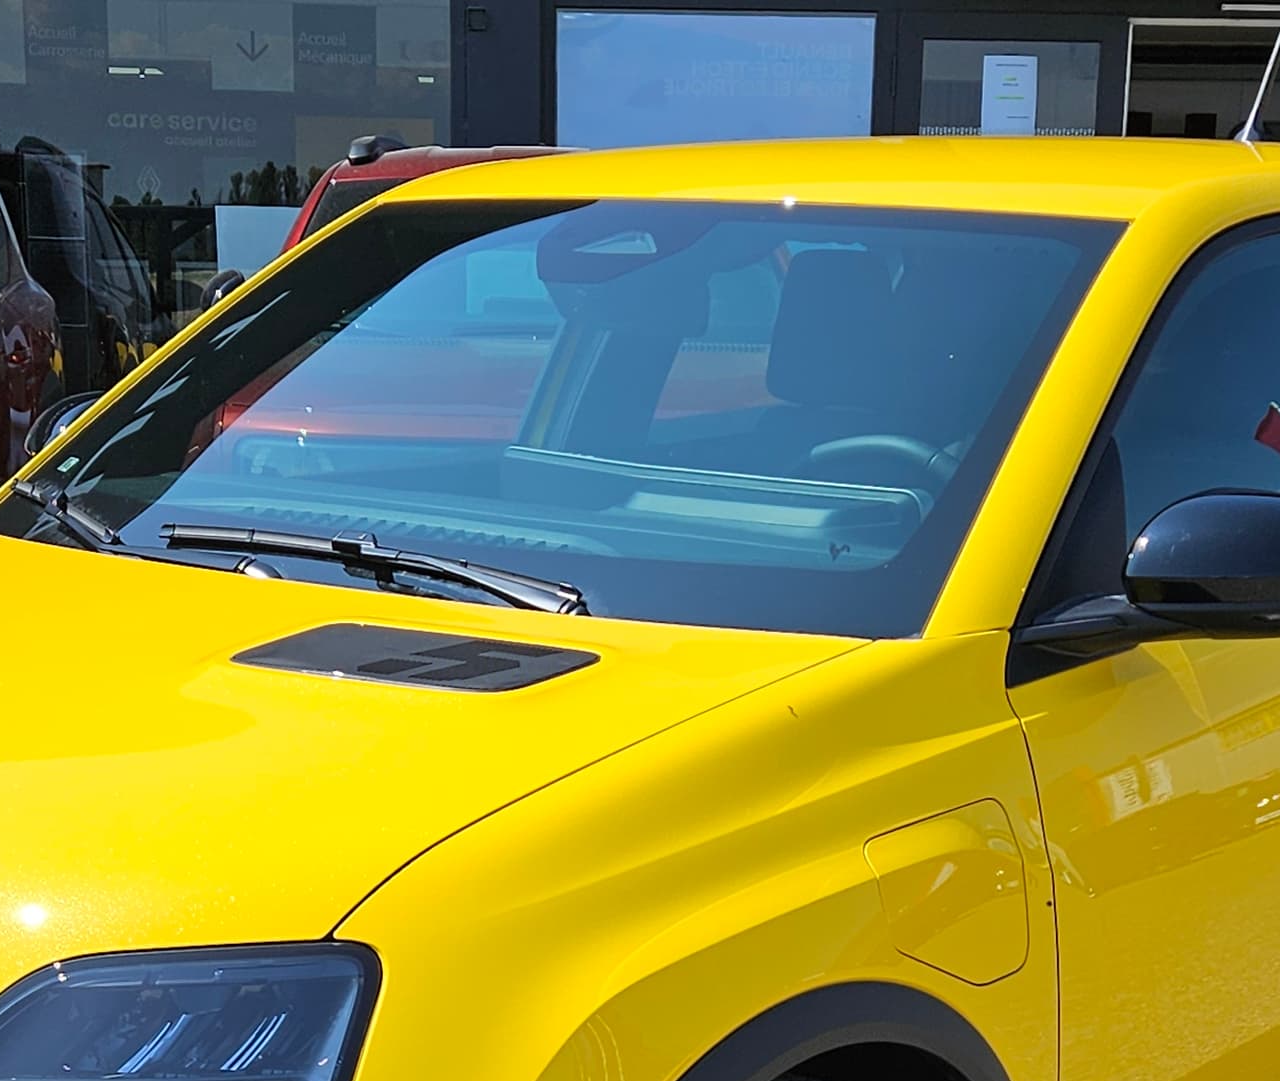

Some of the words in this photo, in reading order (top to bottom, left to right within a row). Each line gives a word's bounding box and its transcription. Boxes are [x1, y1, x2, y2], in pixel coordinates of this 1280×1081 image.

[28, 24, 77, 39] Accueil
[298, 31, 347, 46] Accueil
[107, 112, 163, 129] care
[167, 111, 257, 132] service
